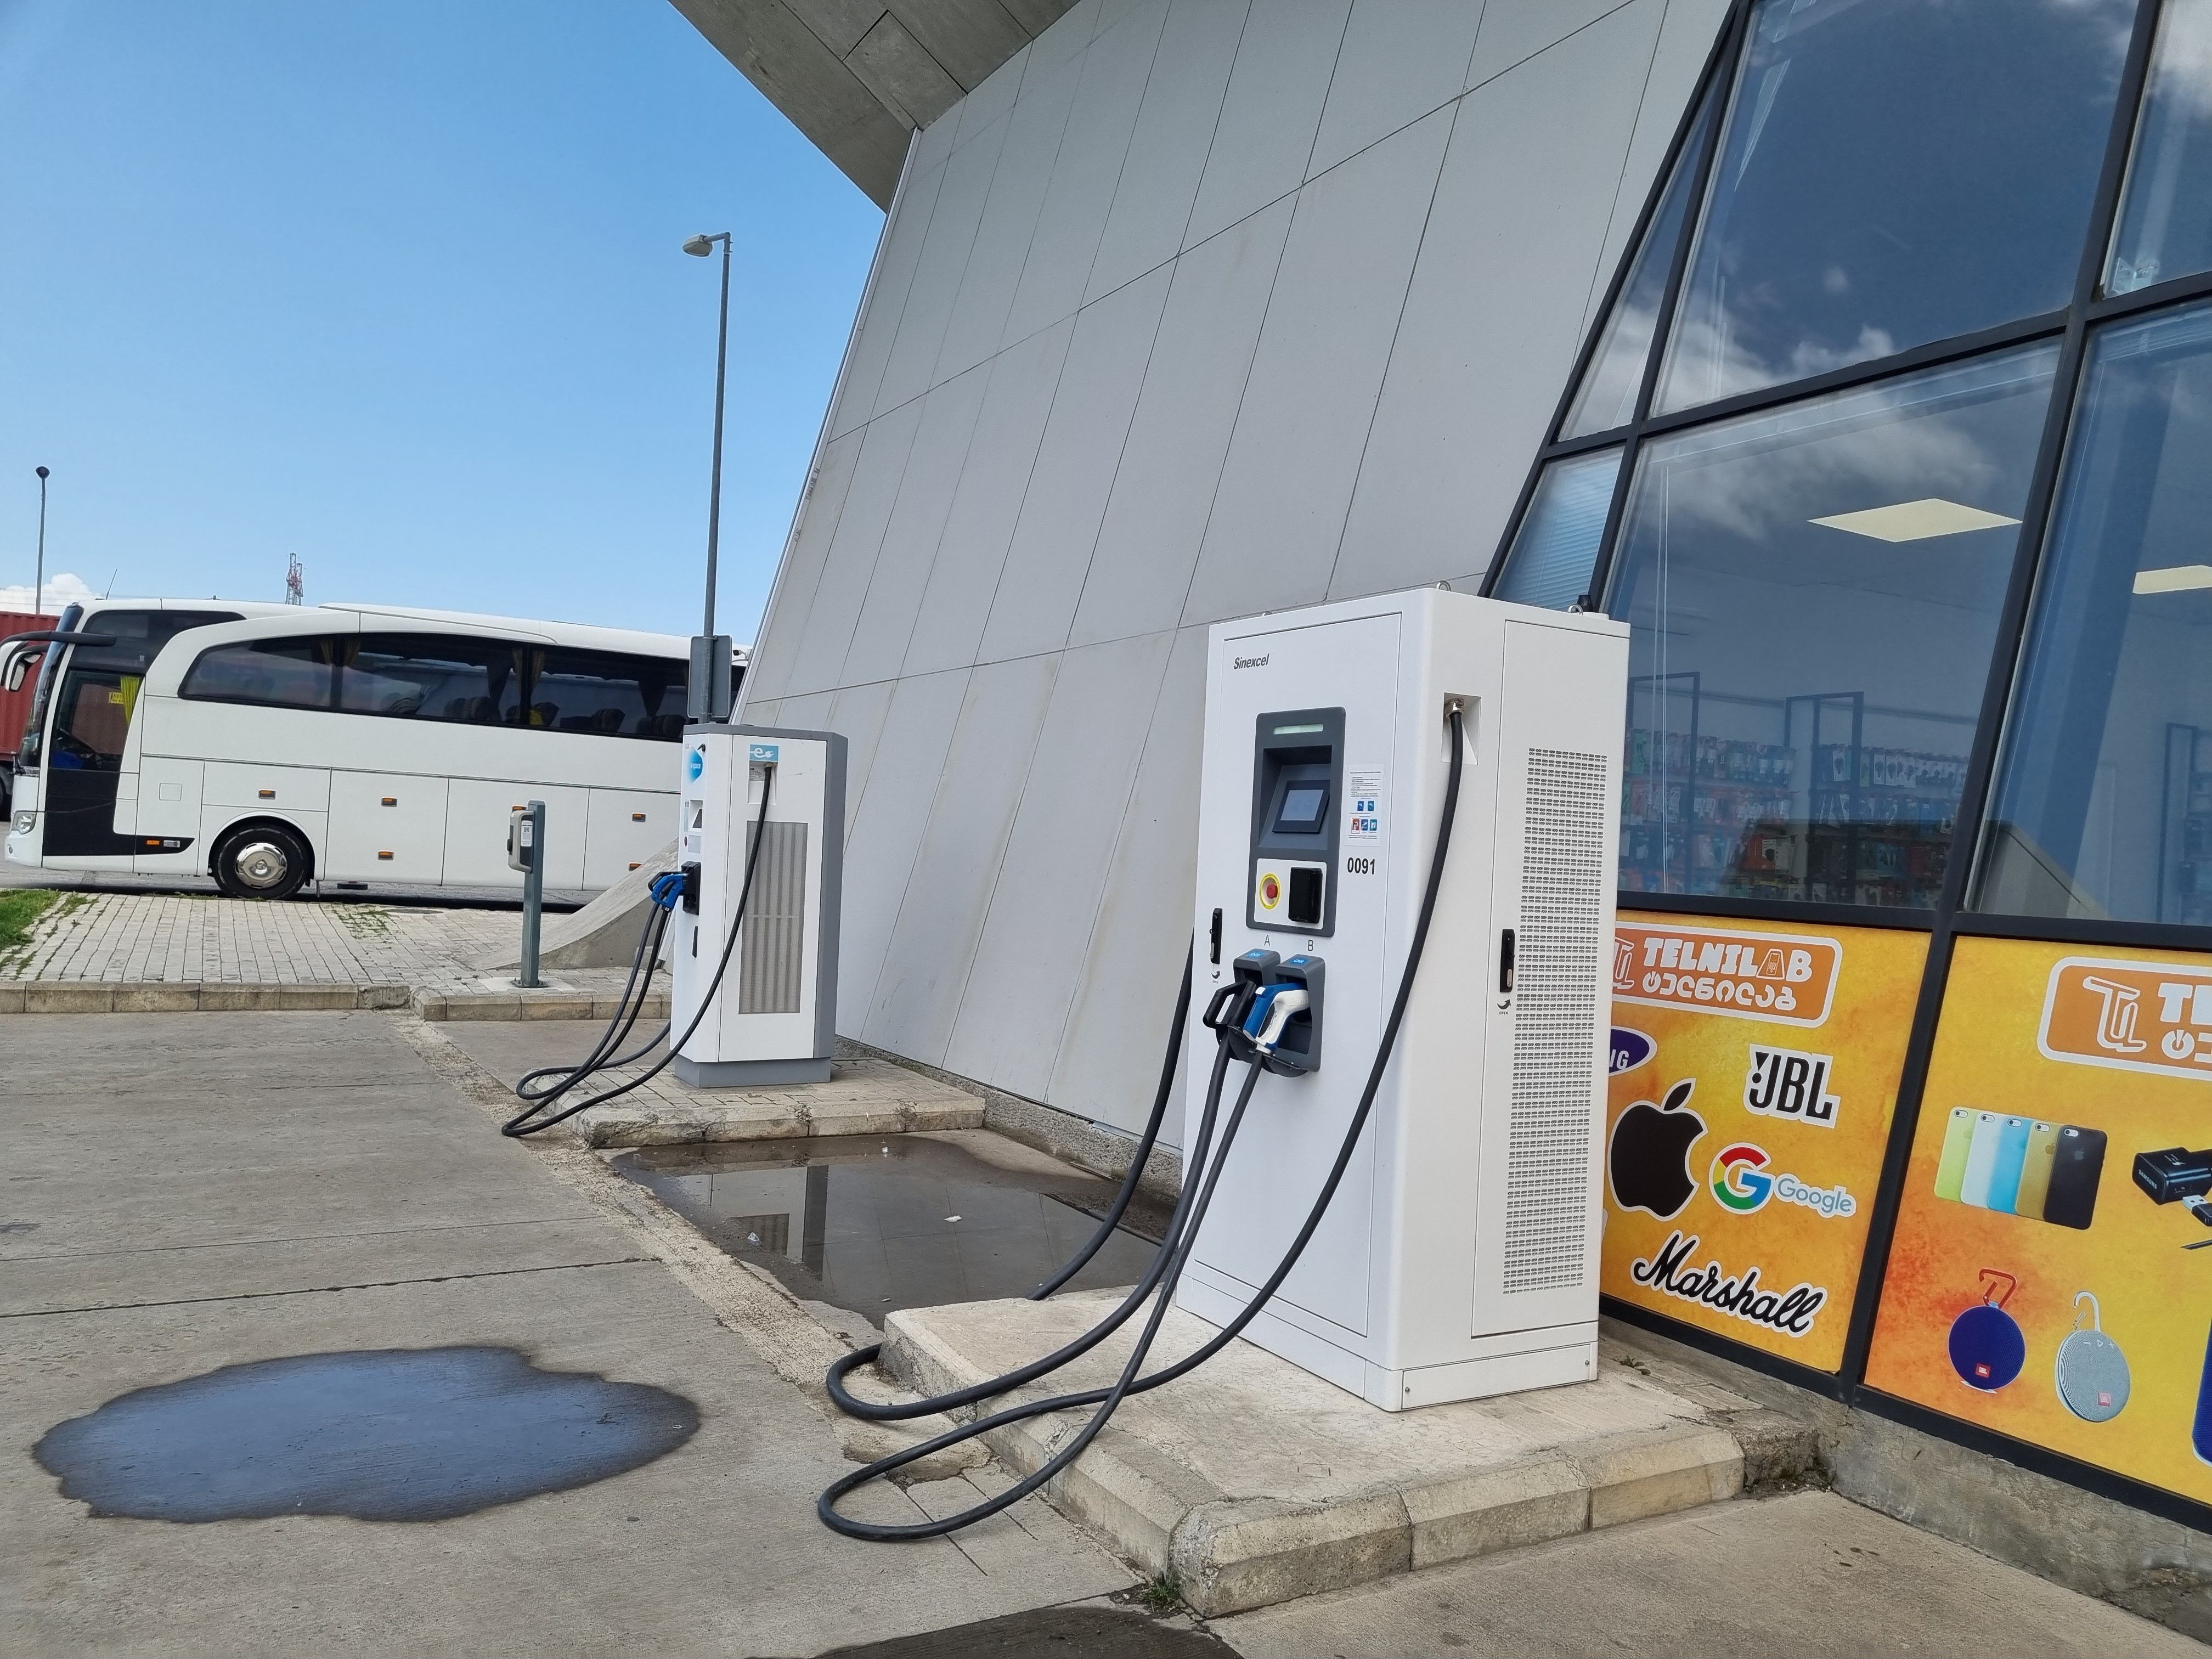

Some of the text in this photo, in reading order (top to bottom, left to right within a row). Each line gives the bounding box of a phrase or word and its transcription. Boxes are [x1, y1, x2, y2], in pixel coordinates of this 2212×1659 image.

[1233, 653, 1270, 670] Sinexcel
[1347, 857, 1375, 875] 0091
[1263, 934, 1271, 947] A
[1307, 939, 1314, 952] B
[1644, 937, 1813, 982] TELNILAB
[1748, 1051, 1833, 1120] JBL
[1777, 1177, 1853, 1214] Google
[1633, 1234, 1824, 1333] Marshall
